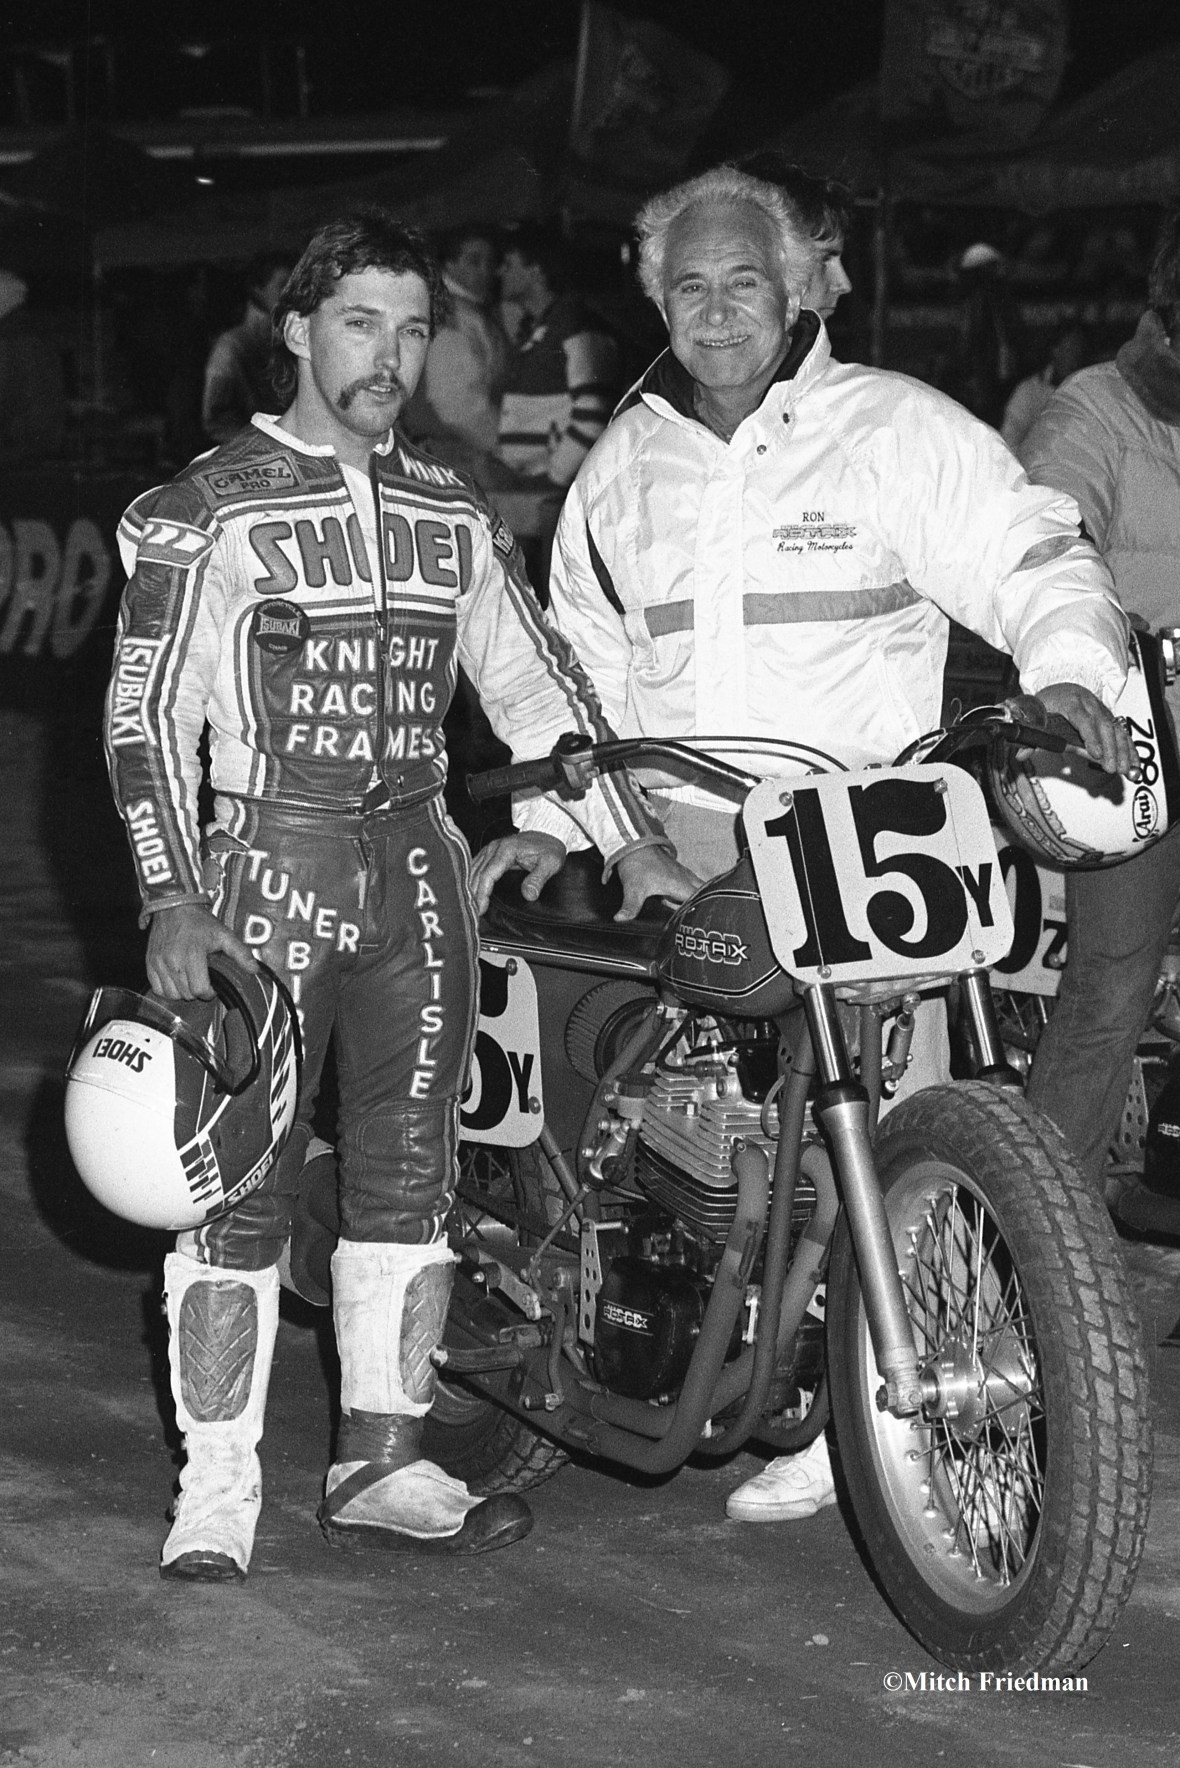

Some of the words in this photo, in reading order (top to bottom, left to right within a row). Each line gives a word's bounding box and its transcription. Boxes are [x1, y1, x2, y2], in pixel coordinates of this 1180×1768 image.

[213, 466, 292, 489] CAMEL
[240, 479, 271, 490] PRO
[802, 511, 825, 523] RON
[249, 510, 473, 596] SHOEI
[776, 541, 804, 555] Racing
[806, 540, 854, 554] Motorcycles
[304, 636, 439, 673] KNIGHT
[289, 681, 436, 716] RACING
[285, 723, 435, 762] FRAMES
[1134, 793, 1153, 837] Arai
[116, 801, 172, 885] SHOEI
[247, 850, 361, 953] TUNER
[675, 932, 749, 960] ROTAX
[406, 847, 444, 1098] CARLISLE
[92, 1038, 153, 1073] SHOEI
